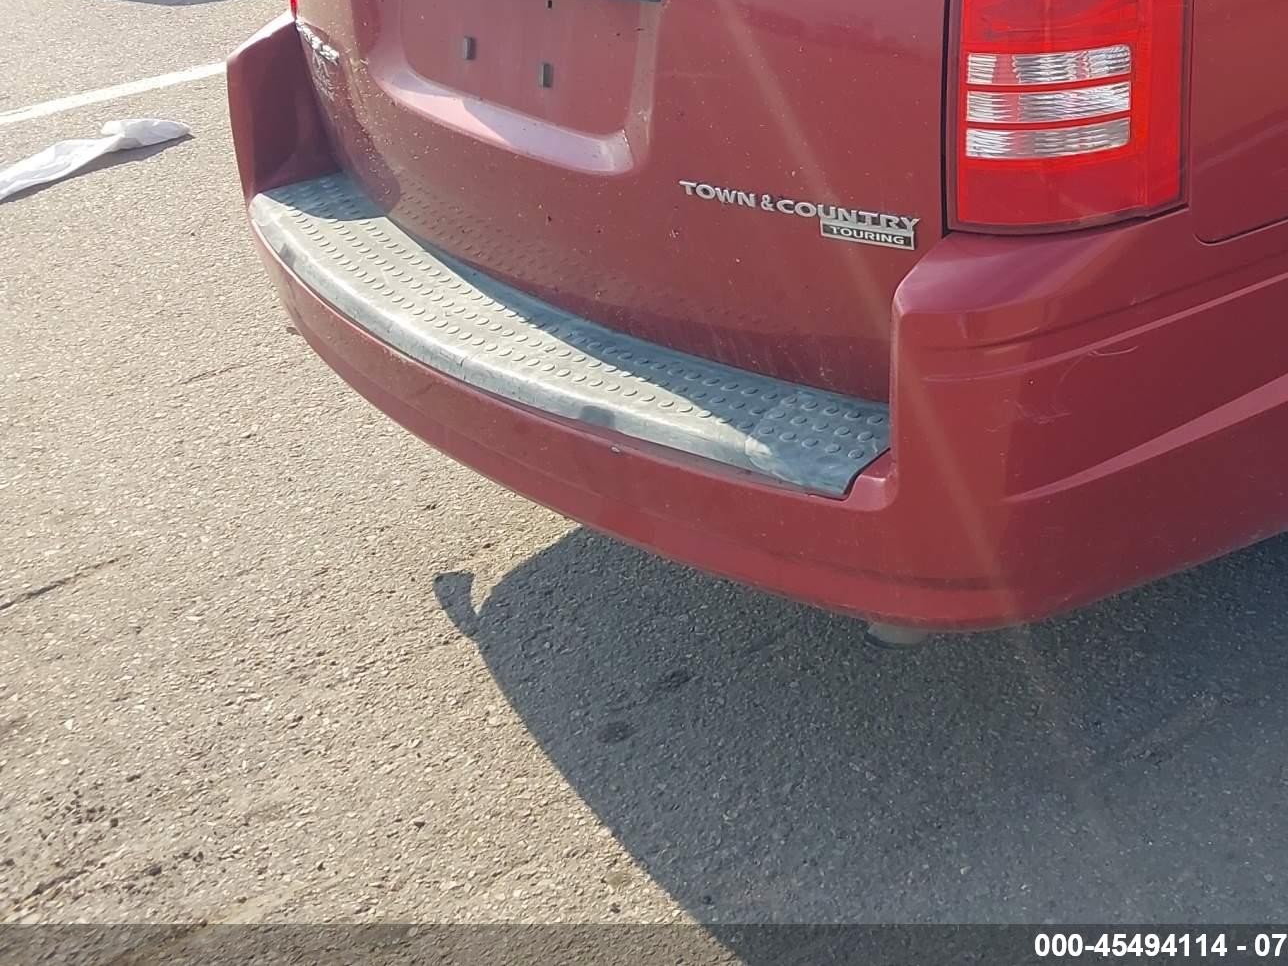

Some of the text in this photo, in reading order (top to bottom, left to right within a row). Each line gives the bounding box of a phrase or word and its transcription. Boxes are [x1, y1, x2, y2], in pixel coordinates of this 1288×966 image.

[679, 180, 756, 208] TOWN
[776, 199, 920, 231] COUNTRY
[830, 225, 905, 245] TOURING
